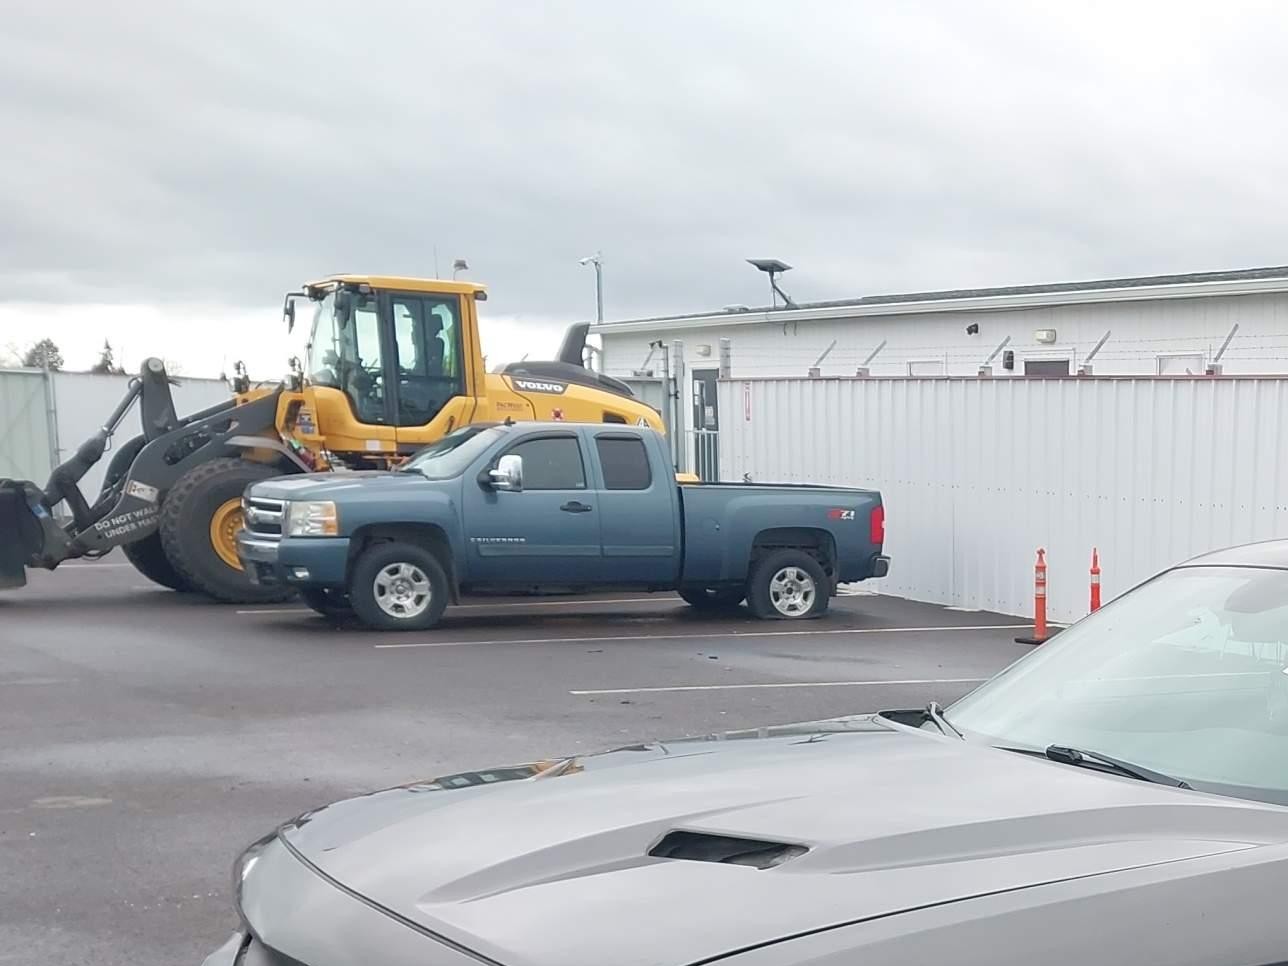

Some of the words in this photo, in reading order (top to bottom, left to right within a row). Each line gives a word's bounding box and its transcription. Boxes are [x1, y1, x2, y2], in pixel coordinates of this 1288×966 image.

[515, 380, 564, 392] VOLVO
[94, 520, 111, 531] DO
[111, 513, 132, 526] NOT
[104, 522, 137, 538] UNDER
